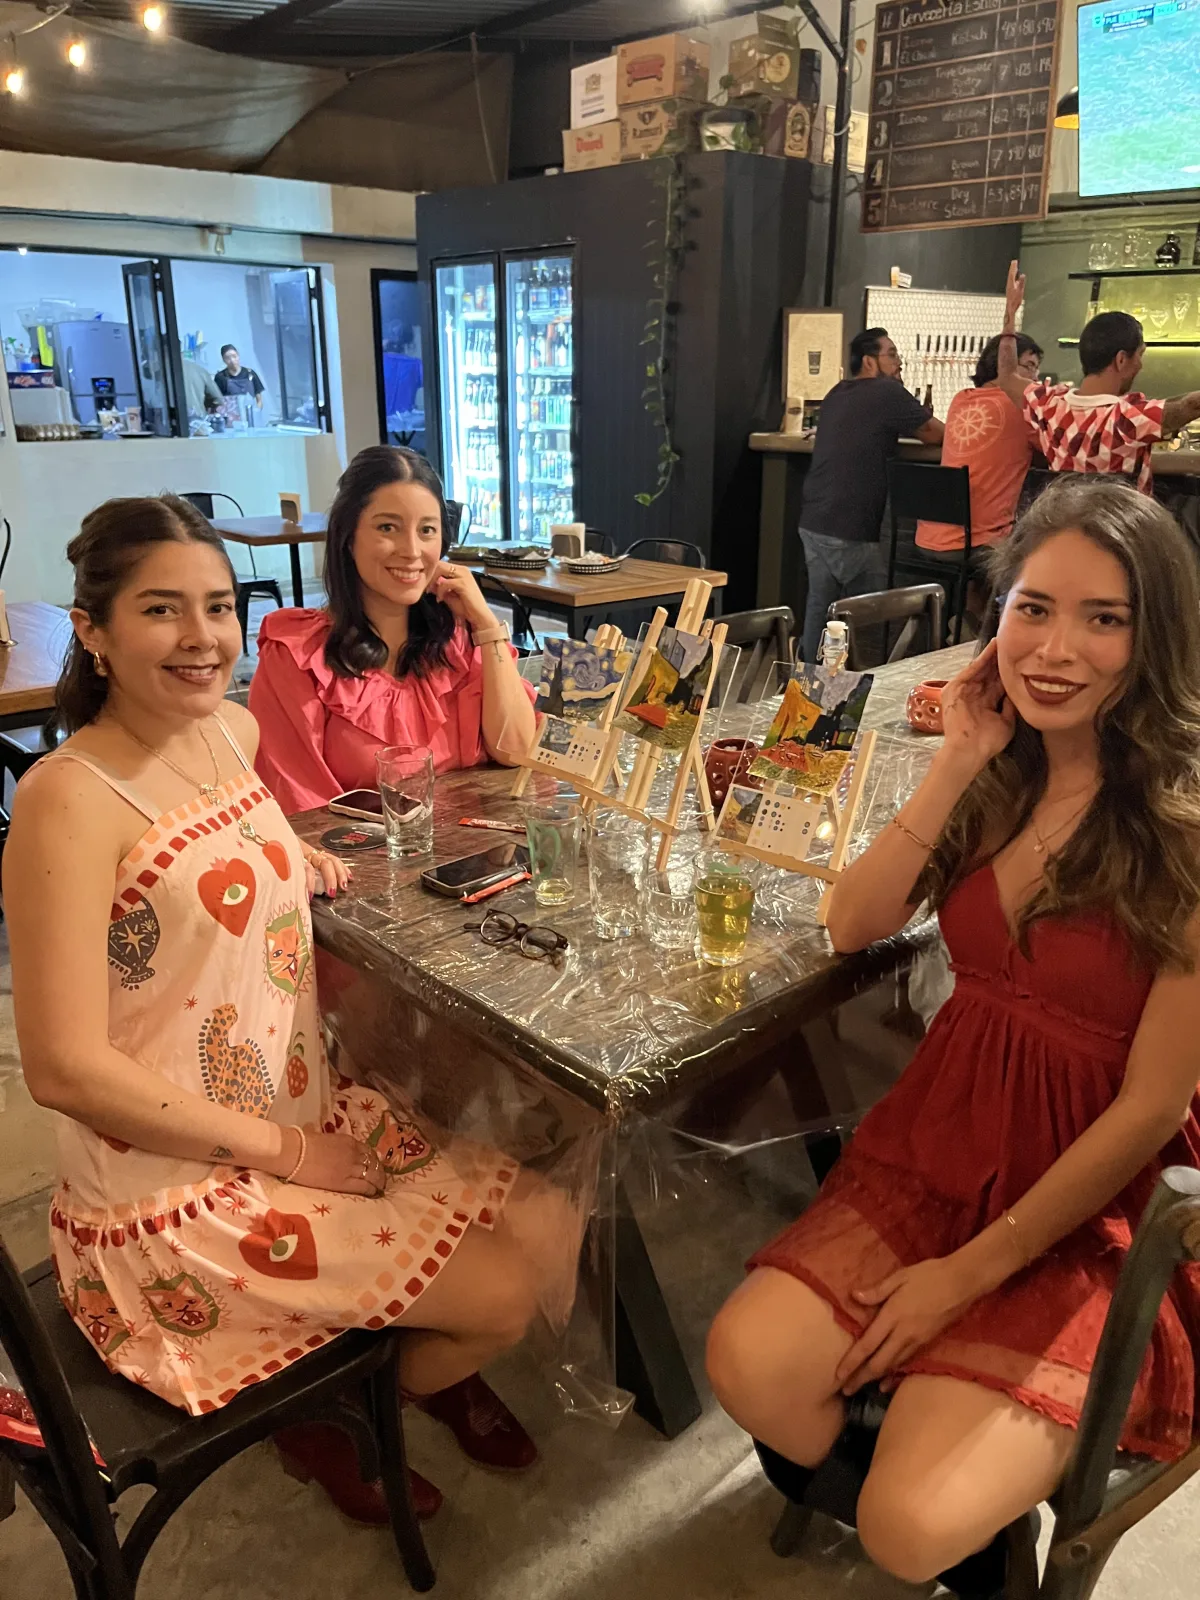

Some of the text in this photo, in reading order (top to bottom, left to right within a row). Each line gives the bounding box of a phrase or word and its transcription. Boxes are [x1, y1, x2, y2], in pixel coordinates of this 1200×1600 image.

[882, 41, 892, 67] 1
[877, 80, 893, 106] 2
[873, 120, 888, 147] 3
[870, 158, 884, 187] 4
[867, 197, 881, 225] 5
